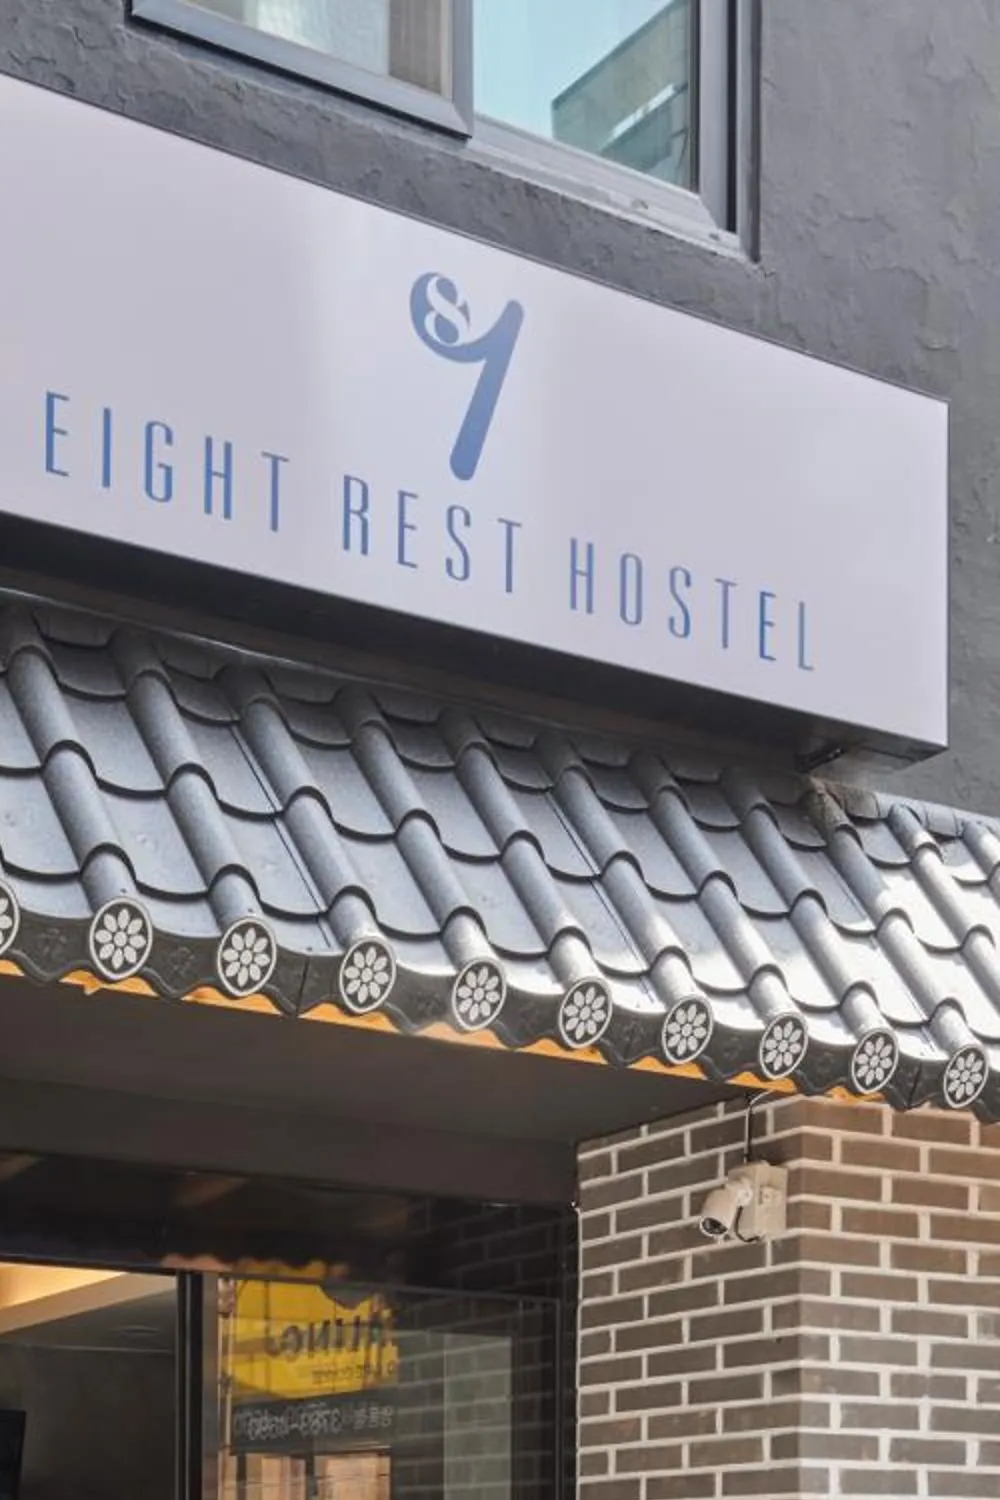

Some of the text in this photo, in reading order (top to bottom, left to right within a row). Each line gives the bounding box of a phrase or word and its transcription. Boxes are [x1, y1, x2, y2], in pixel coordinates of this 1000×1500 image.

[44, 390, 815, 672] EIGHT REST HOSTEL
